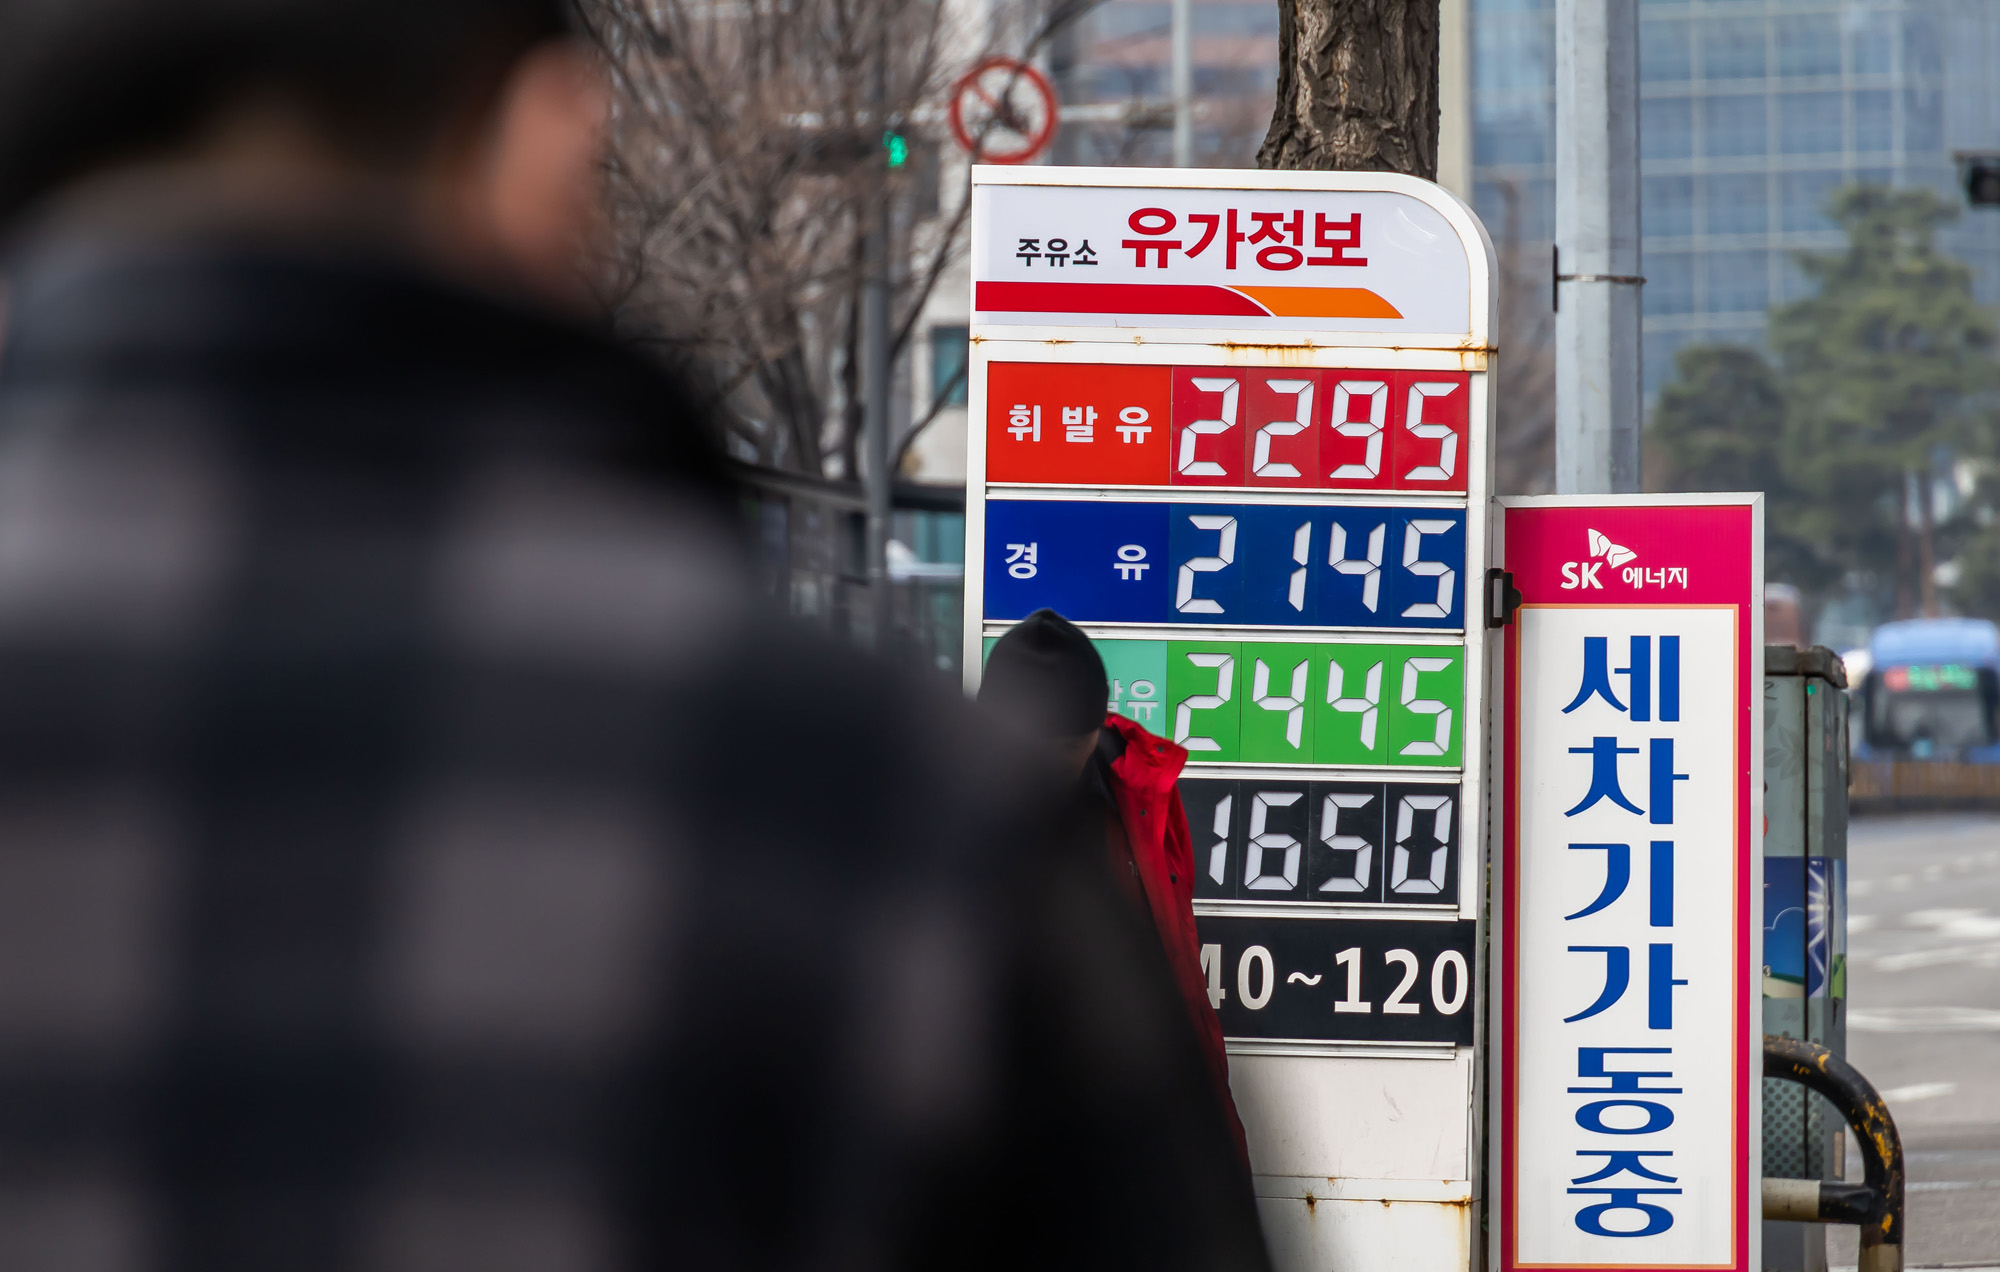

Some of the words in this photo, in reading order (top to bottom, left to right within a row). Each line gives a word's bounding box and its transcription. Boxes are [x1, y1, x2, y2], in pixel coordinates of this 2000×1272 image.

[1016, 238, 1099, 268] 주유소
[1121, 207, 1369, 271] 유가정보
[1178, 377, 1460, 481] 2295
[1175, 515, 1457, 618] 2145
[1560, 561, 1604, 590] SK
[1622, 566, 1689, 590] 에너지
[1173, 652, 1454, 756] 2445
[1208, 791, 1453, 894] 1650
